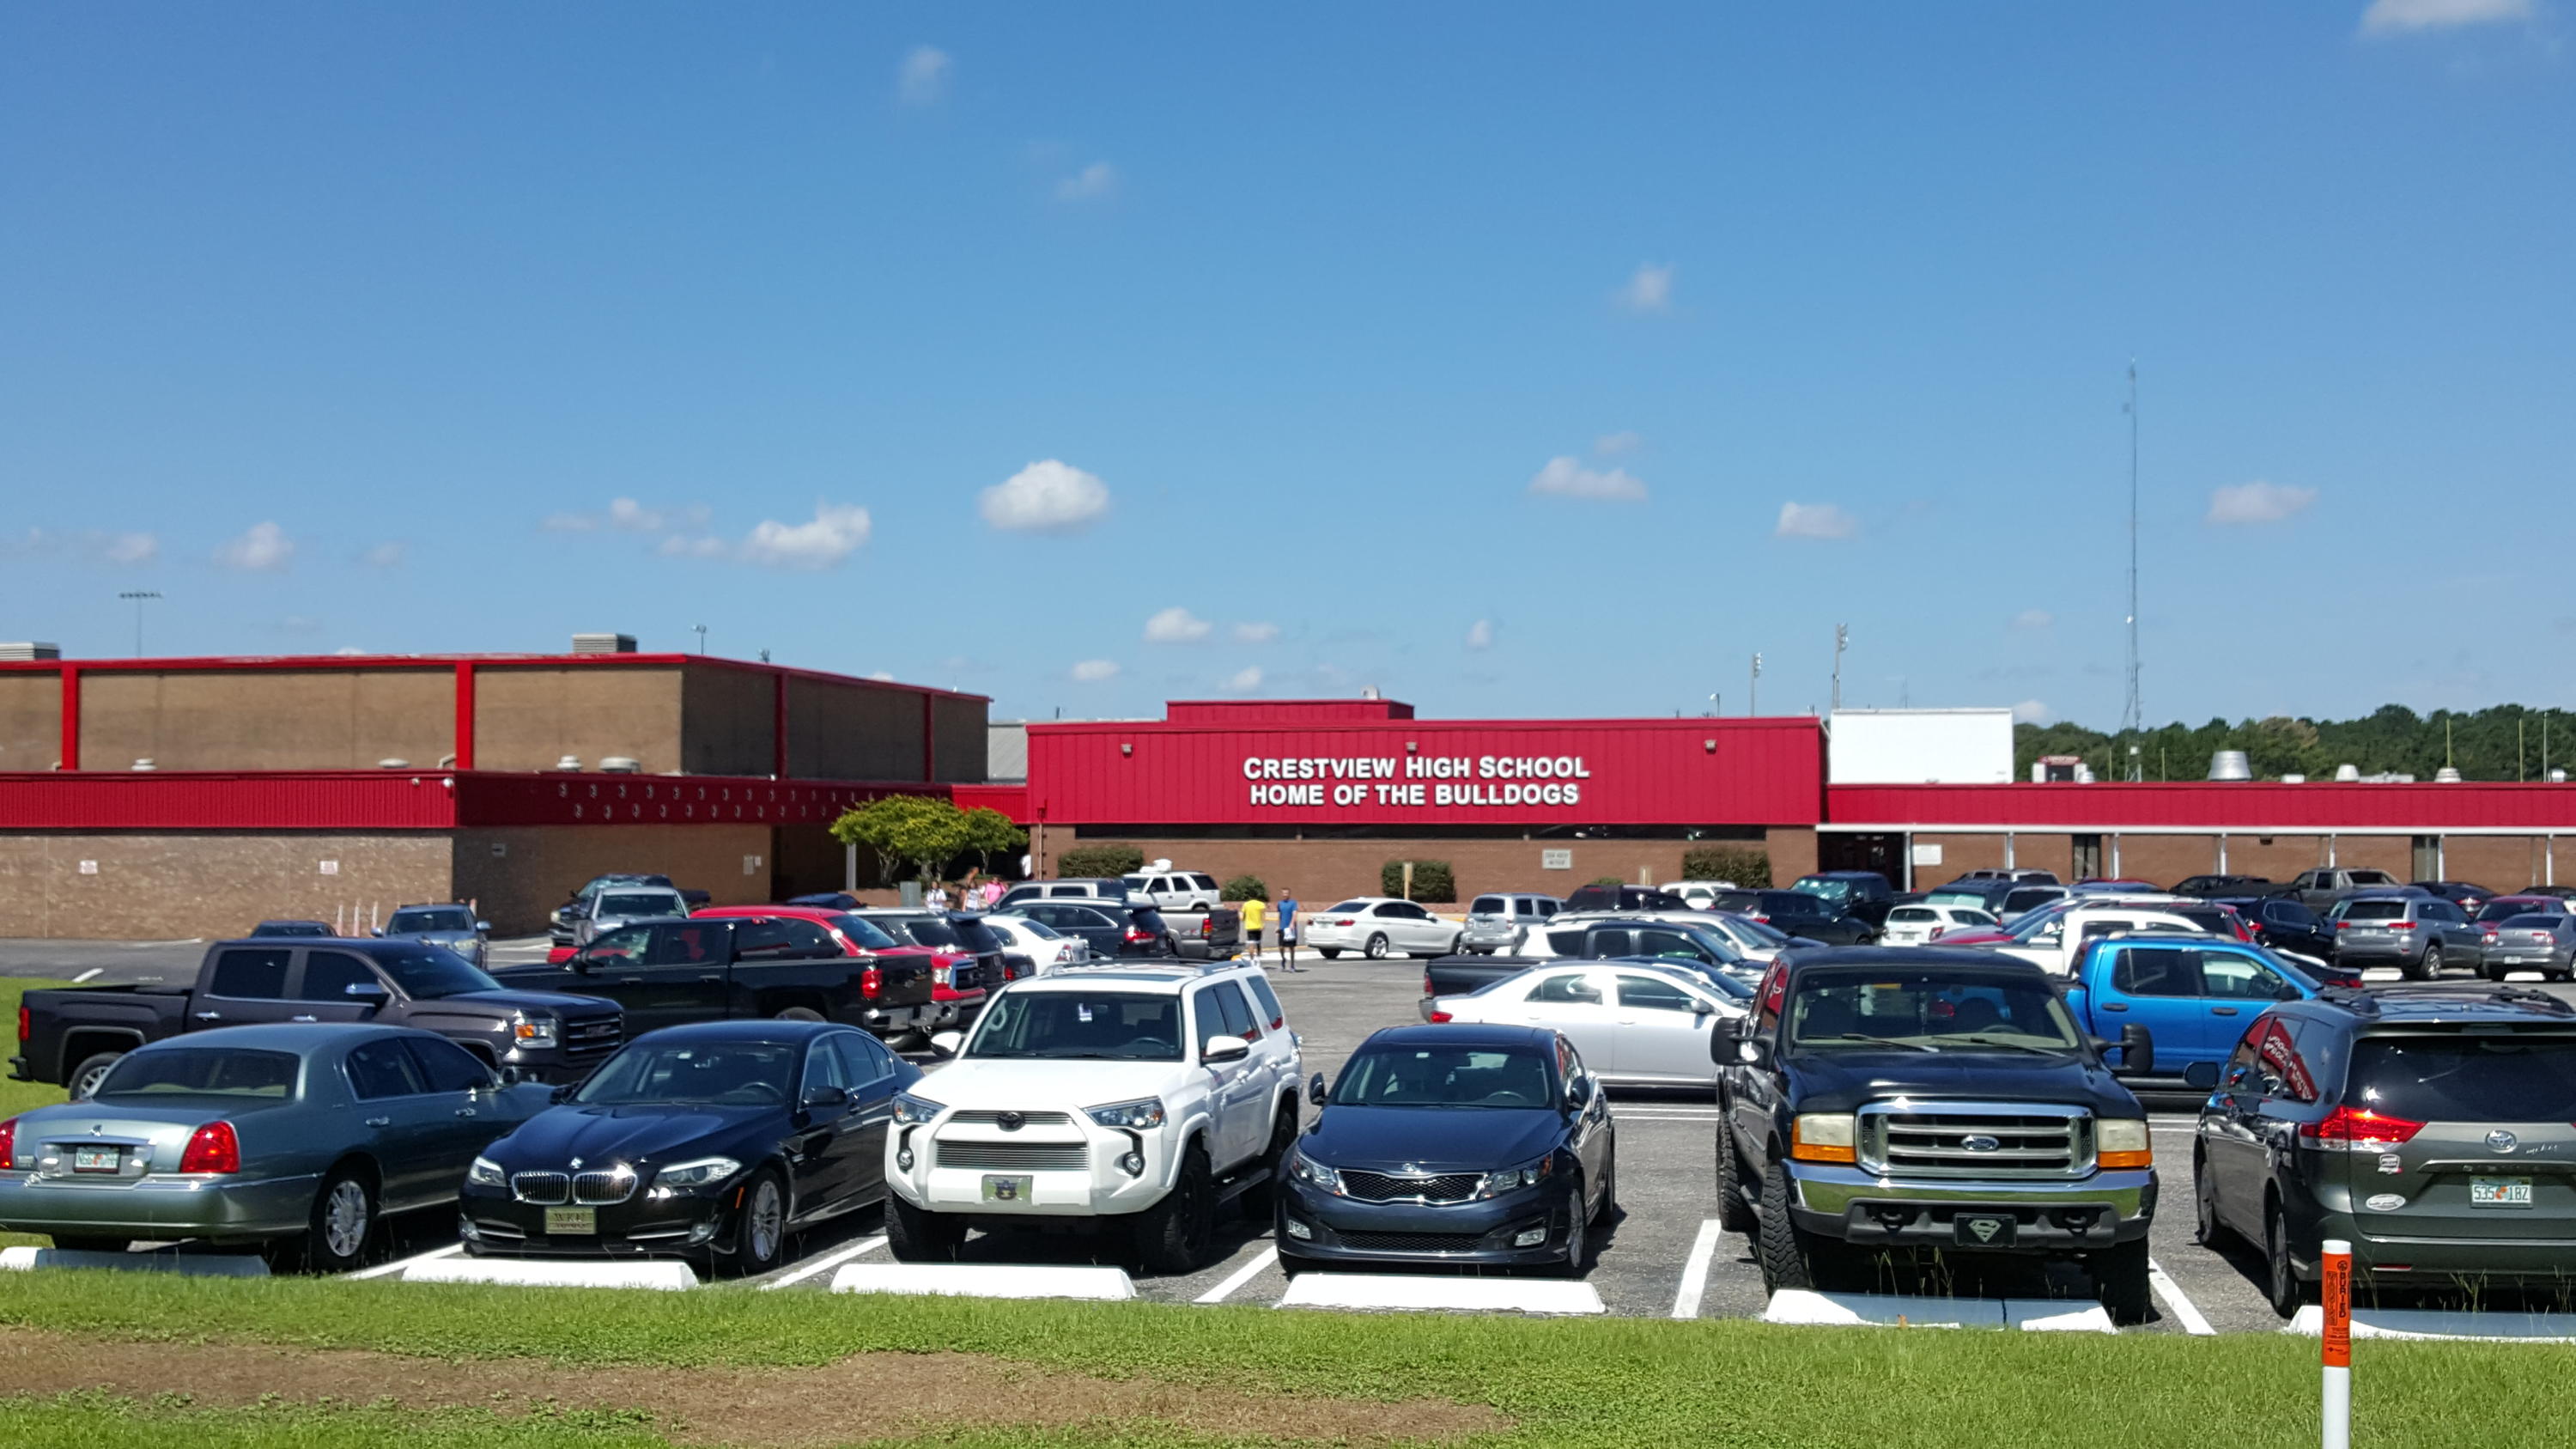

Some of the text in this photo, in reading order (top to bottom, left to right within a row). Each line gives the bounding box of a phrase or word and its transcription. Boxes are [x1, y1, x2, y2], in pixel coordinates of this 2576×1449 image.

[1243, 756, 1589, 780] CRESTVIEW HIGH SCHOOL
[1249, 783, 1580, 806] HOME OF THE BULLDOGS
[2474, 1185, 2495, 1201] 535
